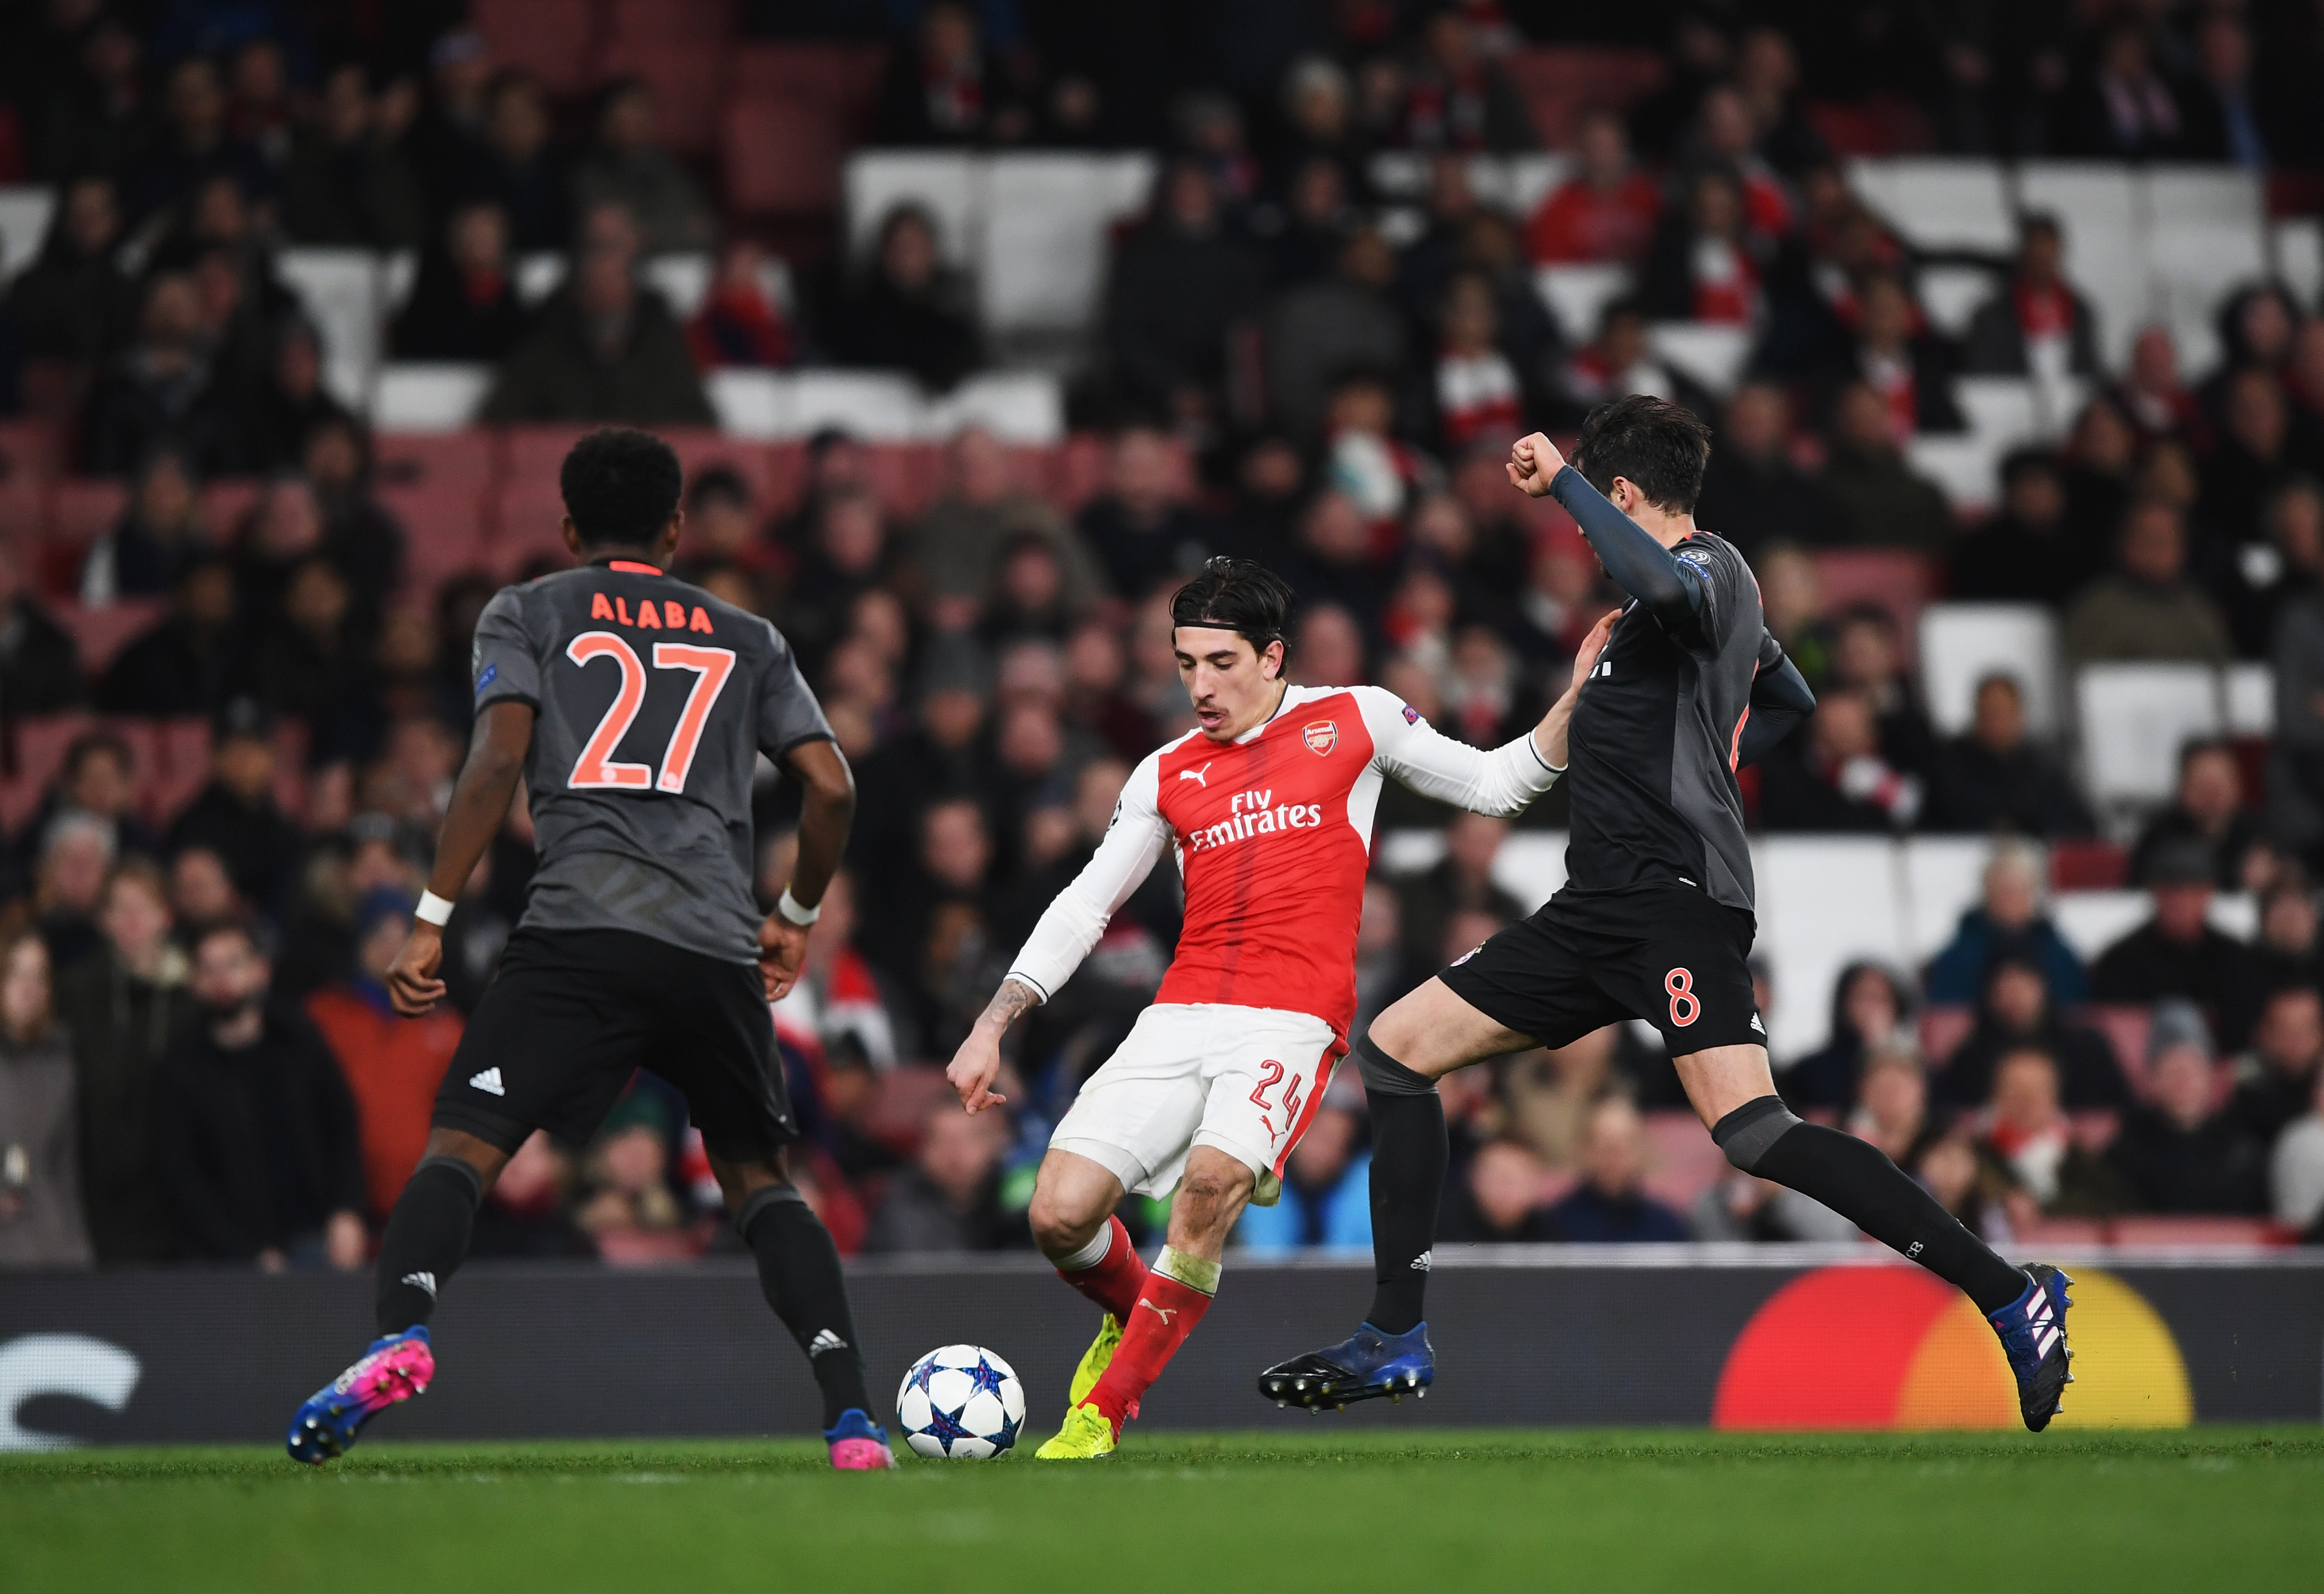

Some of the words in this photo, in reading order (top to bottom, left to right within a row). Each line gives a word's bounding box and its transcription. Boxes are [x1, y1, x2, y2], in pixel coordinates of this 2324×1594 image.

[590, 592, 714, 635] ALABA
[566, 630, 736, 794] 27
[1307, 725, 1332, 736] Arsenal
[1231, 789, 1271, 813] Fly
[1189, 803, 1321, 852] Emirates
[1664, 967, 1701, 1027] 8
[1249, 1059, 1301, 1131] 24
